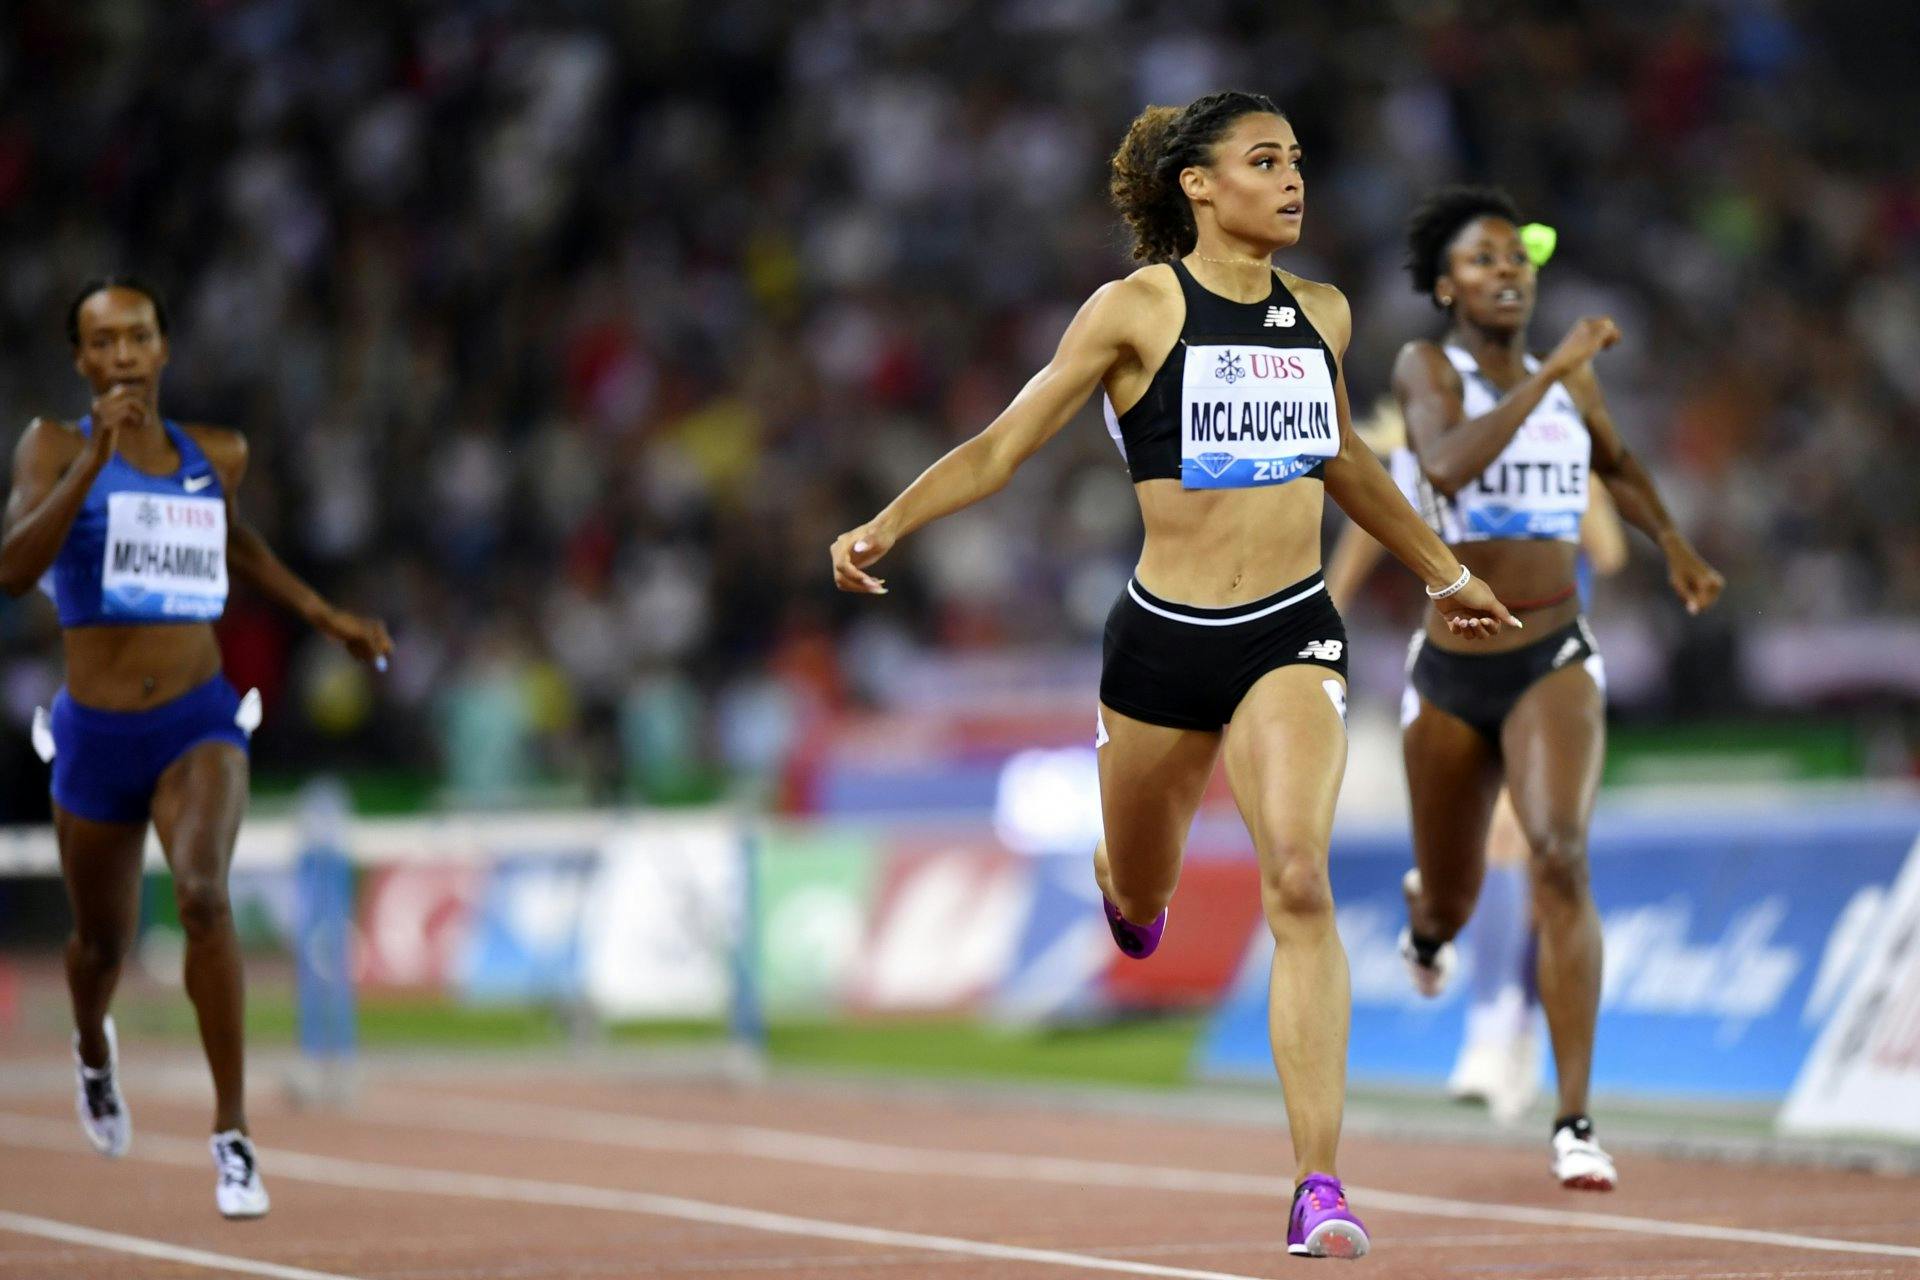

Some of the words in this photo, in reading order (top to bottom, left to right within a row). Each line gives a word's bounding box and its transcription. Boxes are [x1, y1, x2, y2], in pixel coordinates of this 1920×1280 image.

[1263, 305, 1296, 328] NB
[1249, 354, 1305, 379] UBS
[1191, 401, 1331, 441] MCLAUGHLIN
[1478, 463, 1580, 494] LITTLE
